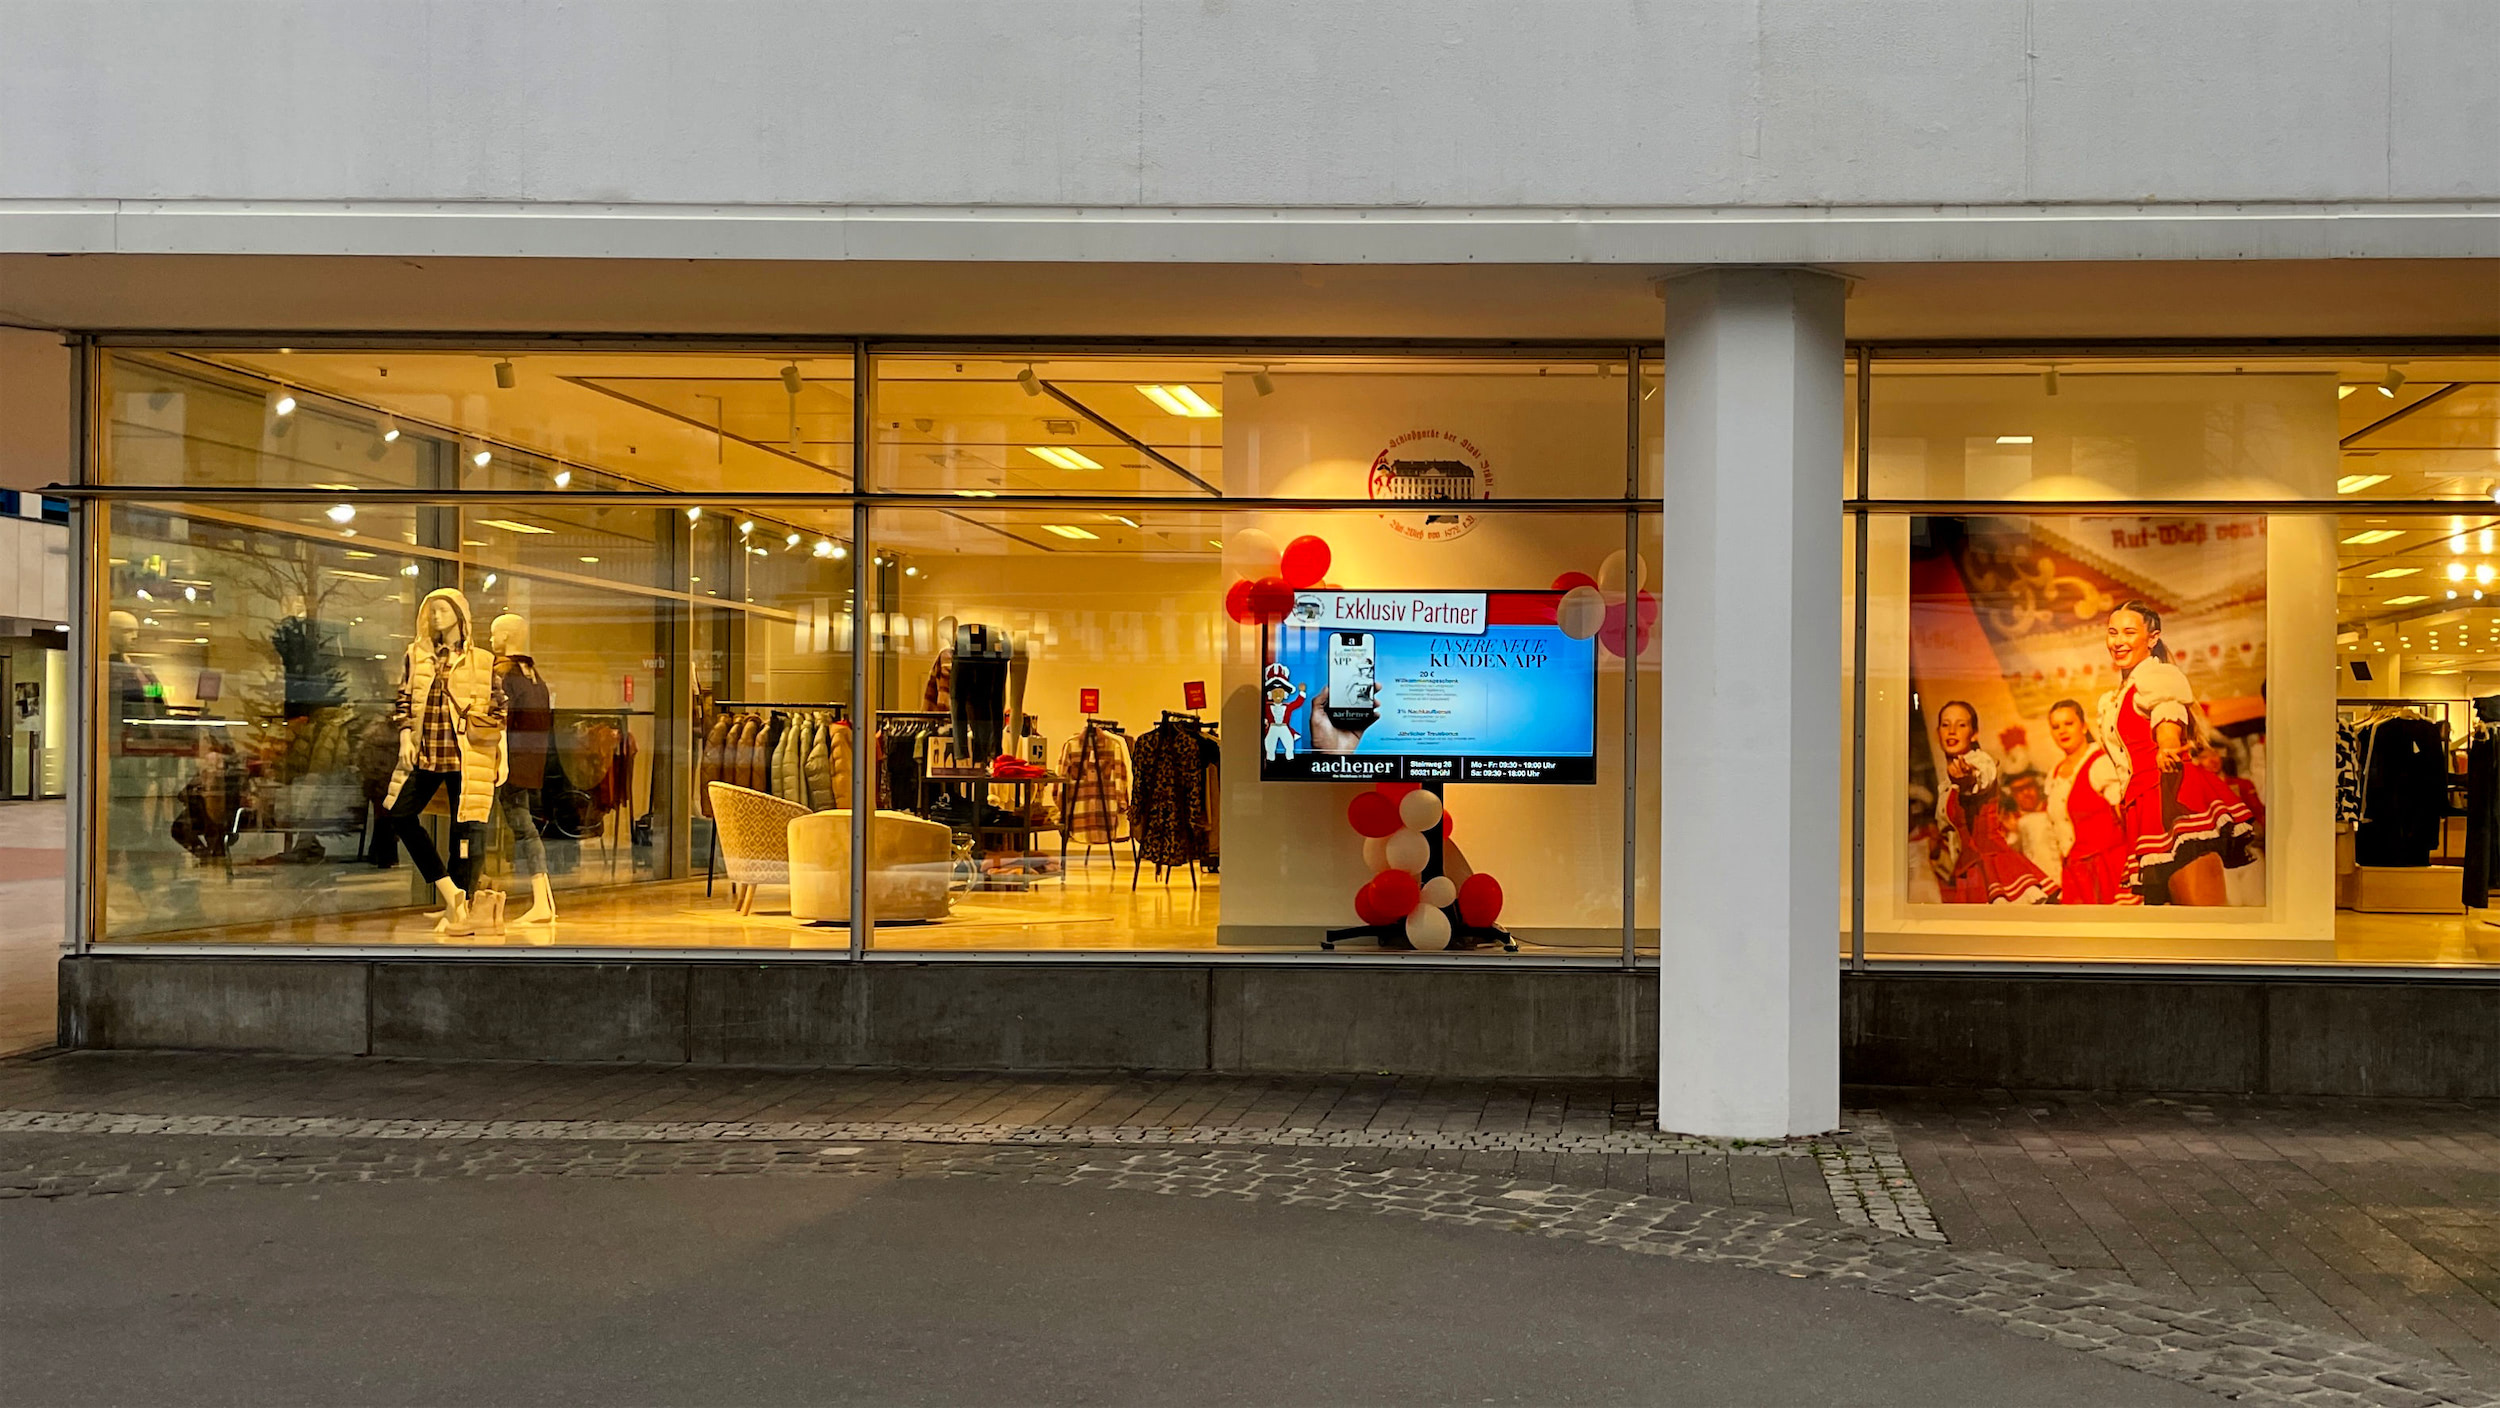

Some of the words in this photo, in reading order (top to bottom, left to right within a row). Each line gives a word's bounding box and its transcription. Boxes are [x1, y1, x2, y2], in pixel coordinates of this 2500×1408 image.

[1443, 431, 1457, 443] der
[1460, 438, 1481, 459] Stadt
[1480, 459, 1495, 487] Brühl
[1335, 596, 1406, 622] Exklusiv
[1412, 599, 1478, 625] Partner
[1430, 639, 1497, 654] UNSERE
[1498, 639, 1547, 654] NEUE
[1333, 657, 1352, 666] APP
[1430, 653, 1507, 667] KUNDEN
[1511, 654, 1548, 668] APP
[1311, 756, 1394, 774] aachener
[1410, 760, 1442, 769] Steinweg
